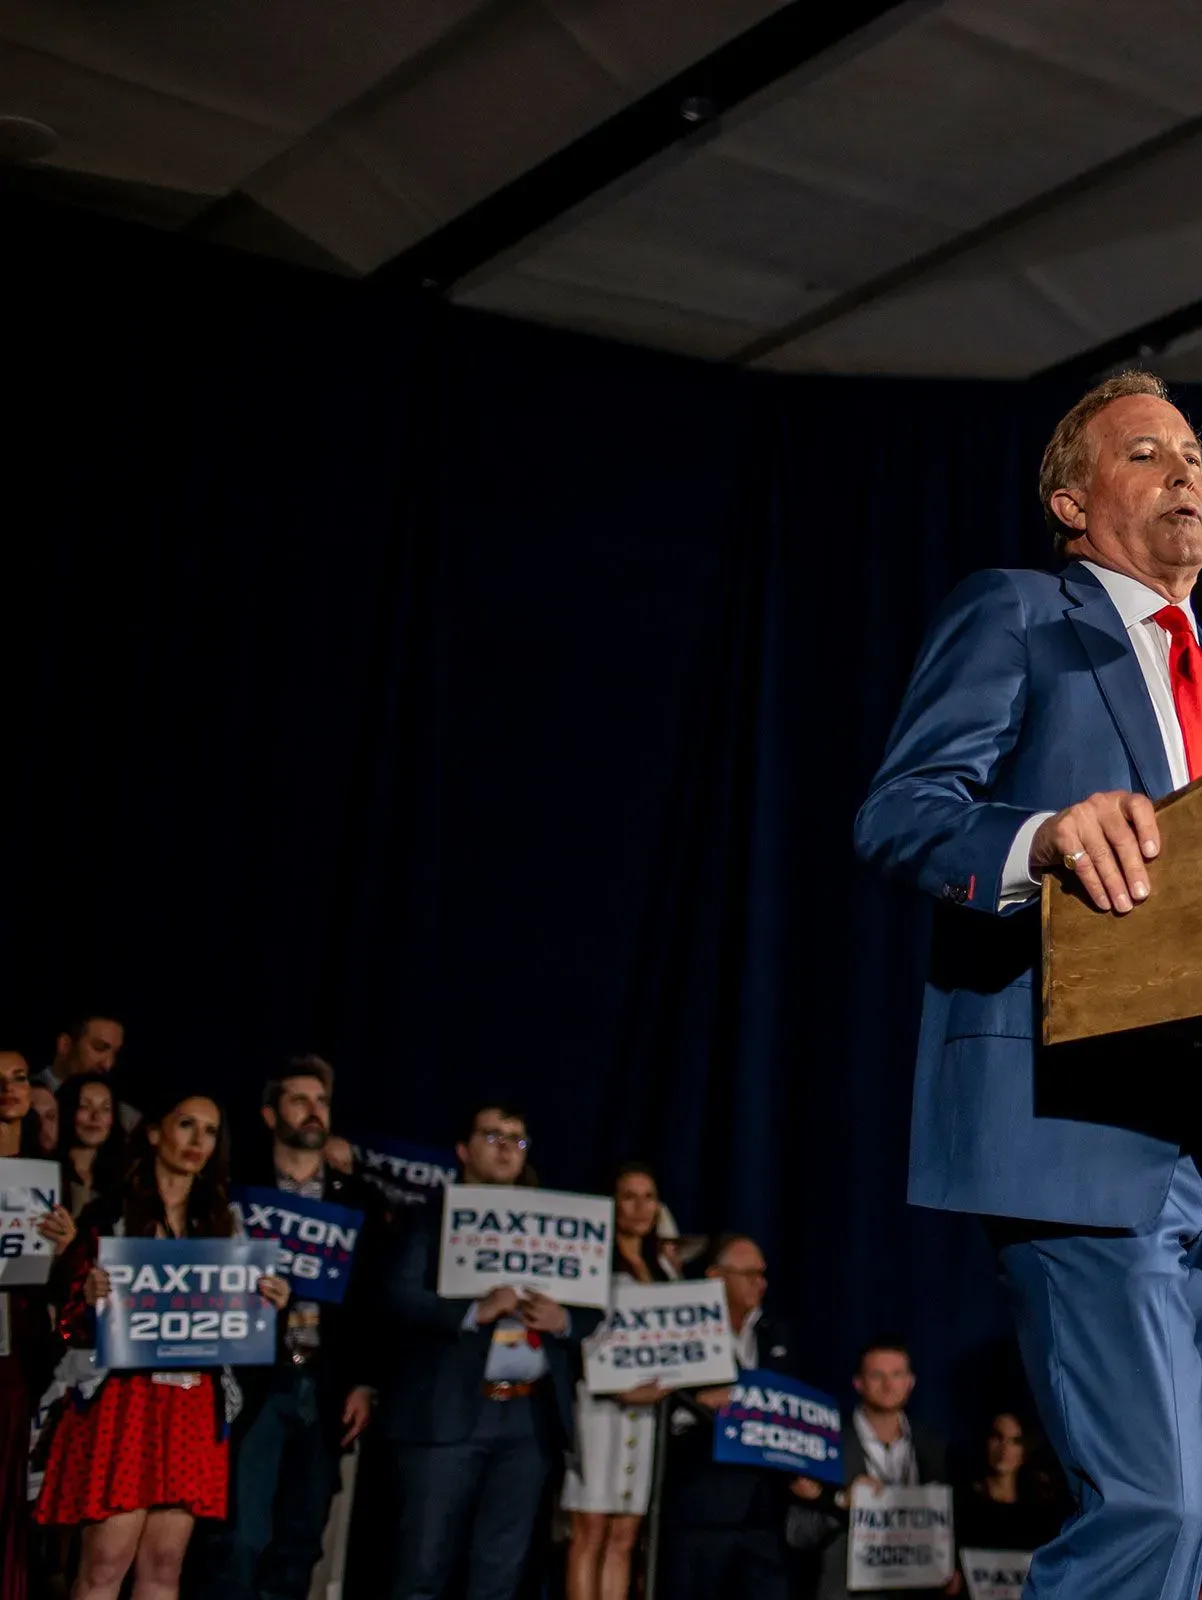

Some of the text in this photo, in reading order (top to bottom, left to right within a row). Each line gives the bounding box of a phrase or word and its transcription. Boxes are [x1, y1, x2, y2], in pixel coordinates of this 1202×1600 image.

[452, 1208, 607, 1241] PAXTON
[475, 1249, 582, 1279] 2026
[129, 1310, 249, 1340] 2026
[610, 1301, 721, 1329] AXTON
[612, 1341, 706, 1370] 2026
[740, 1420, 827, 1462] 2026
